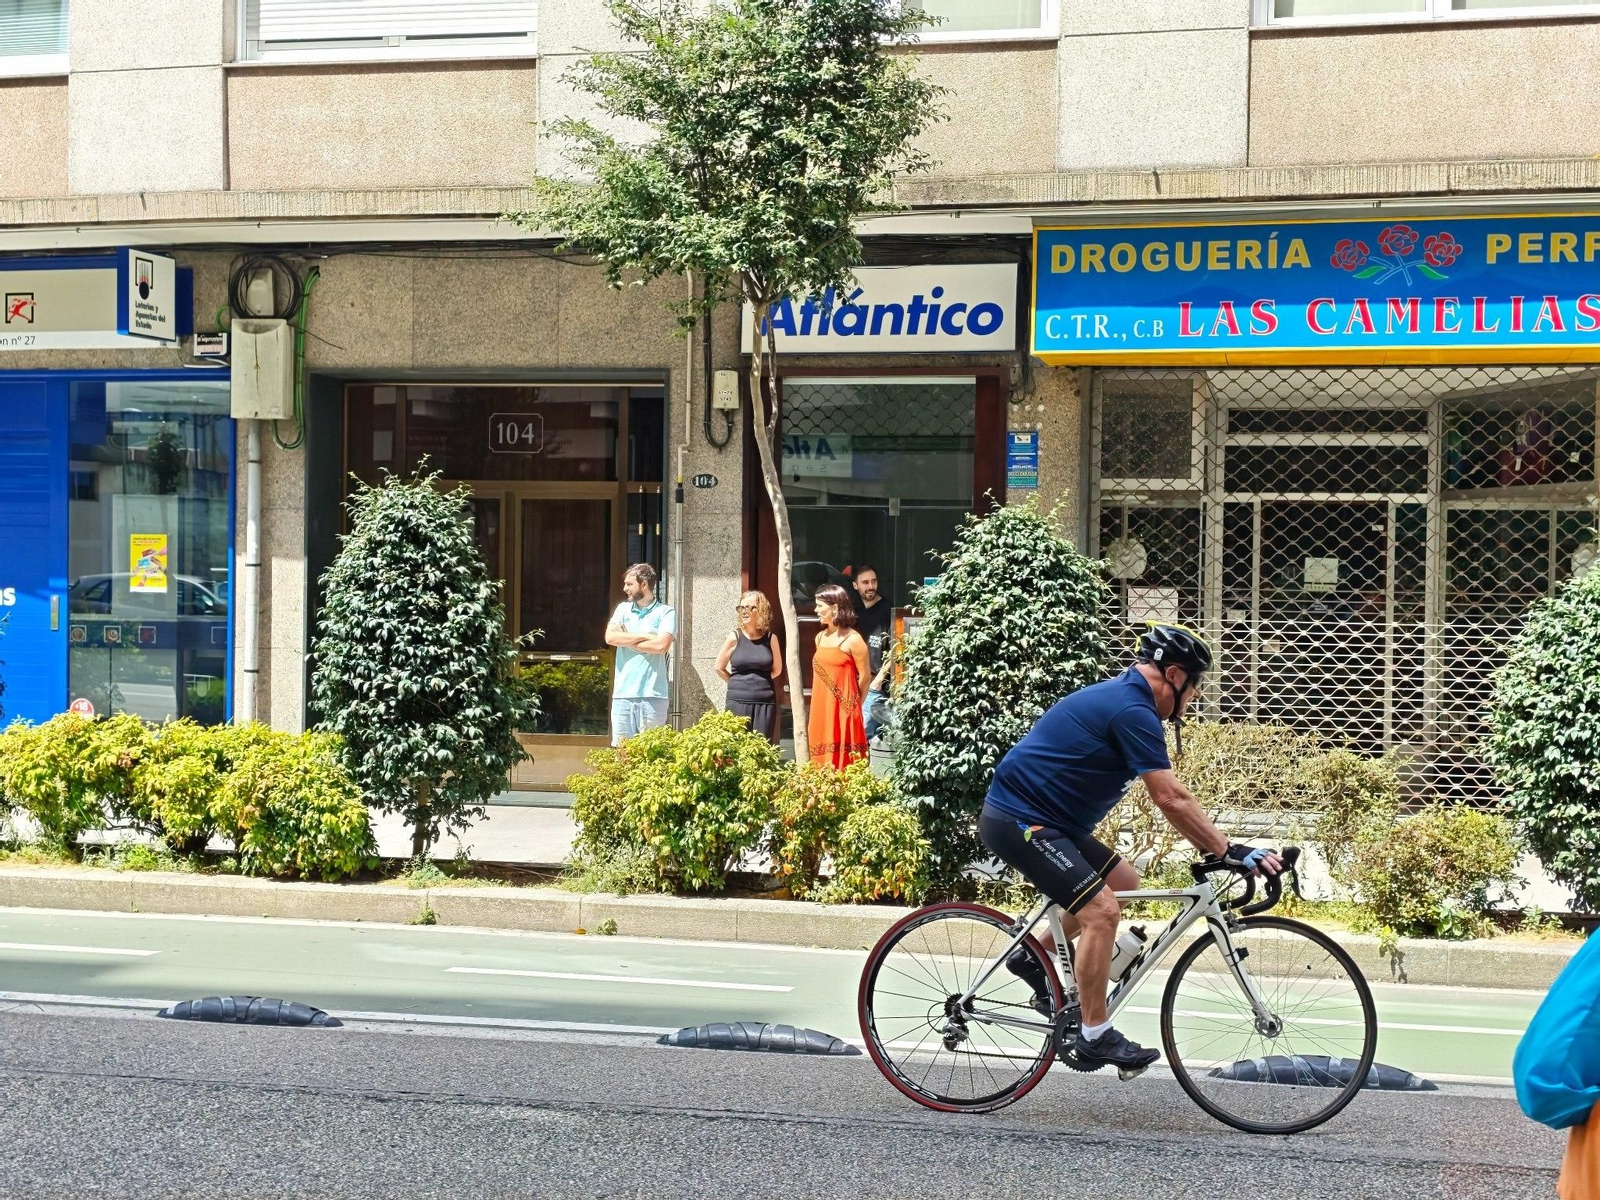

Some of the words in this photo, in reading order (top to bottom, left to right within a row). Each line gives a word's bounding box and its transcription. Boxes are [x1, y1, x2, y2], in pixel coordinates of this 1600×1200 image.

[1050, 231, 1312, 274] DROGUERÍA
[1486, 231, 1600, 264] PERF
[158, 314, 166, 323] del
[760, 285, 1004, 337] Atlántico
[1178, 299, 1279, 338] LAS
[1305, 293, 1600, 335] CAMELIAS
[135, 319, 152, 330] Estado
[1045, 314, 1127, 342] C.T.R.,
[1133, 319, 1164, 338] C.B
[24, 335, 36, 346] 27
[496, 422, 535, 445] 104
[693, 475, 716, 487] 104
[0, 587, 17, 607] s
[1056, 851, 1075, 868] Energy
